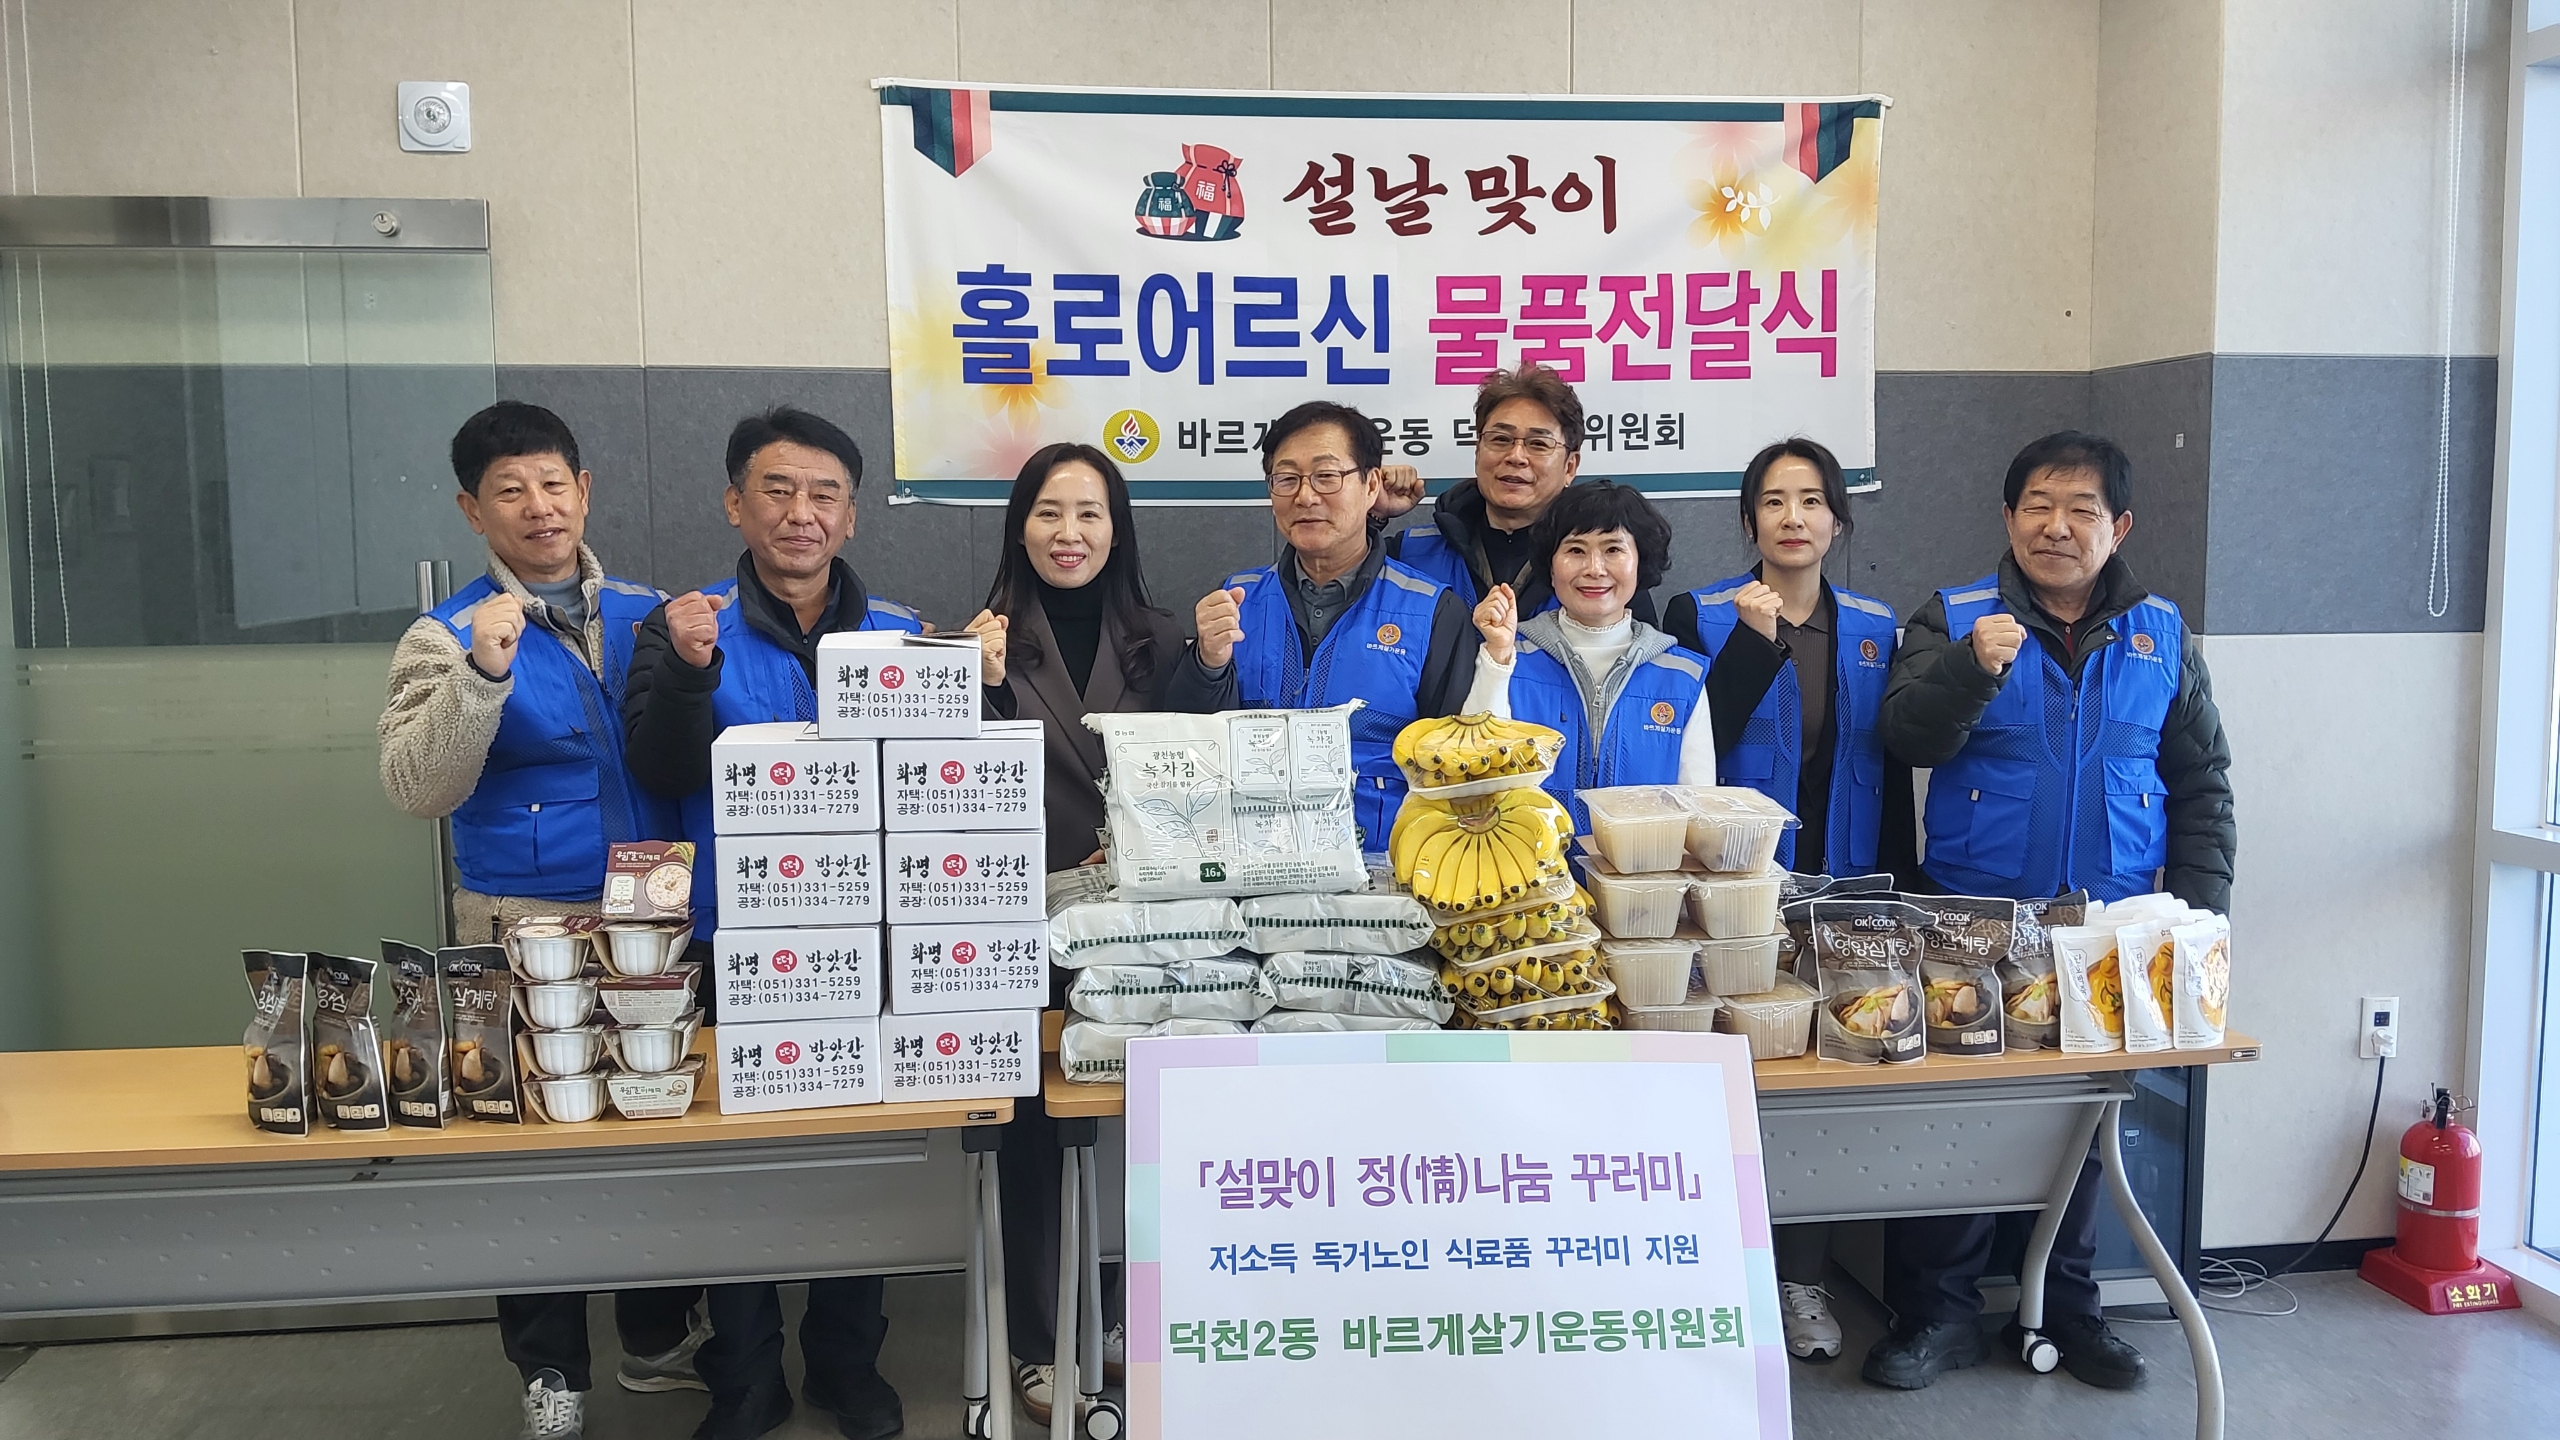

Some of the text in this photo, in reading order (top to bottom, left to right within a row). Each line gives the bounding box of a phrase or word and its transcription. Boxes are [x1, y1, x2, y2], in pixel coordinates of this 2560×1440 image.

[1196, 180, 1216, 202] 福
[1281, 152, 1619, 238] 설날 맞이
[1158, 198, 1172, 211] 福
[953, 263, 1837, 387] 홀로어르신 물품전달식
[836, 664, 971, 690] 화명 떡 방앗간
[1152, 750, 1184, 761] 광천농협
[724, 761, 860, 786] 화명 떡 방앗간
[896, 760, 1028, 785] 화명 떡 방앗간
[1142, 761, 1195, 779] 녹차김
[737, 853, 871, 879] 화명 떡 방앗간
[899, 853, 1030, 878] 화명 떡 방앗간
[1872, 918, 1898, 927] COOK
[1943, 912, 1970, 922] COOK
[727, 949, 862, 976] 화명 떡 방앗간
[911, 939, 1041, 964] 화명 떡 방앗간
[730, 1037, 865, 1068] 화명 떡 방앗간
[893, 1032, 1023, 1058] 화명 떡 방앗간
[1356, 1153, 1554, 1207] 정(情)나눔
[1208, 1233, 1700, 1274] 저소득 독거노인 식료품 꾸러미 지원
[2451, 1282, 2498, 1302] 소화기
[1168, 1307, 1746, 1363] 덕천2동 바르게살기운동위원회
